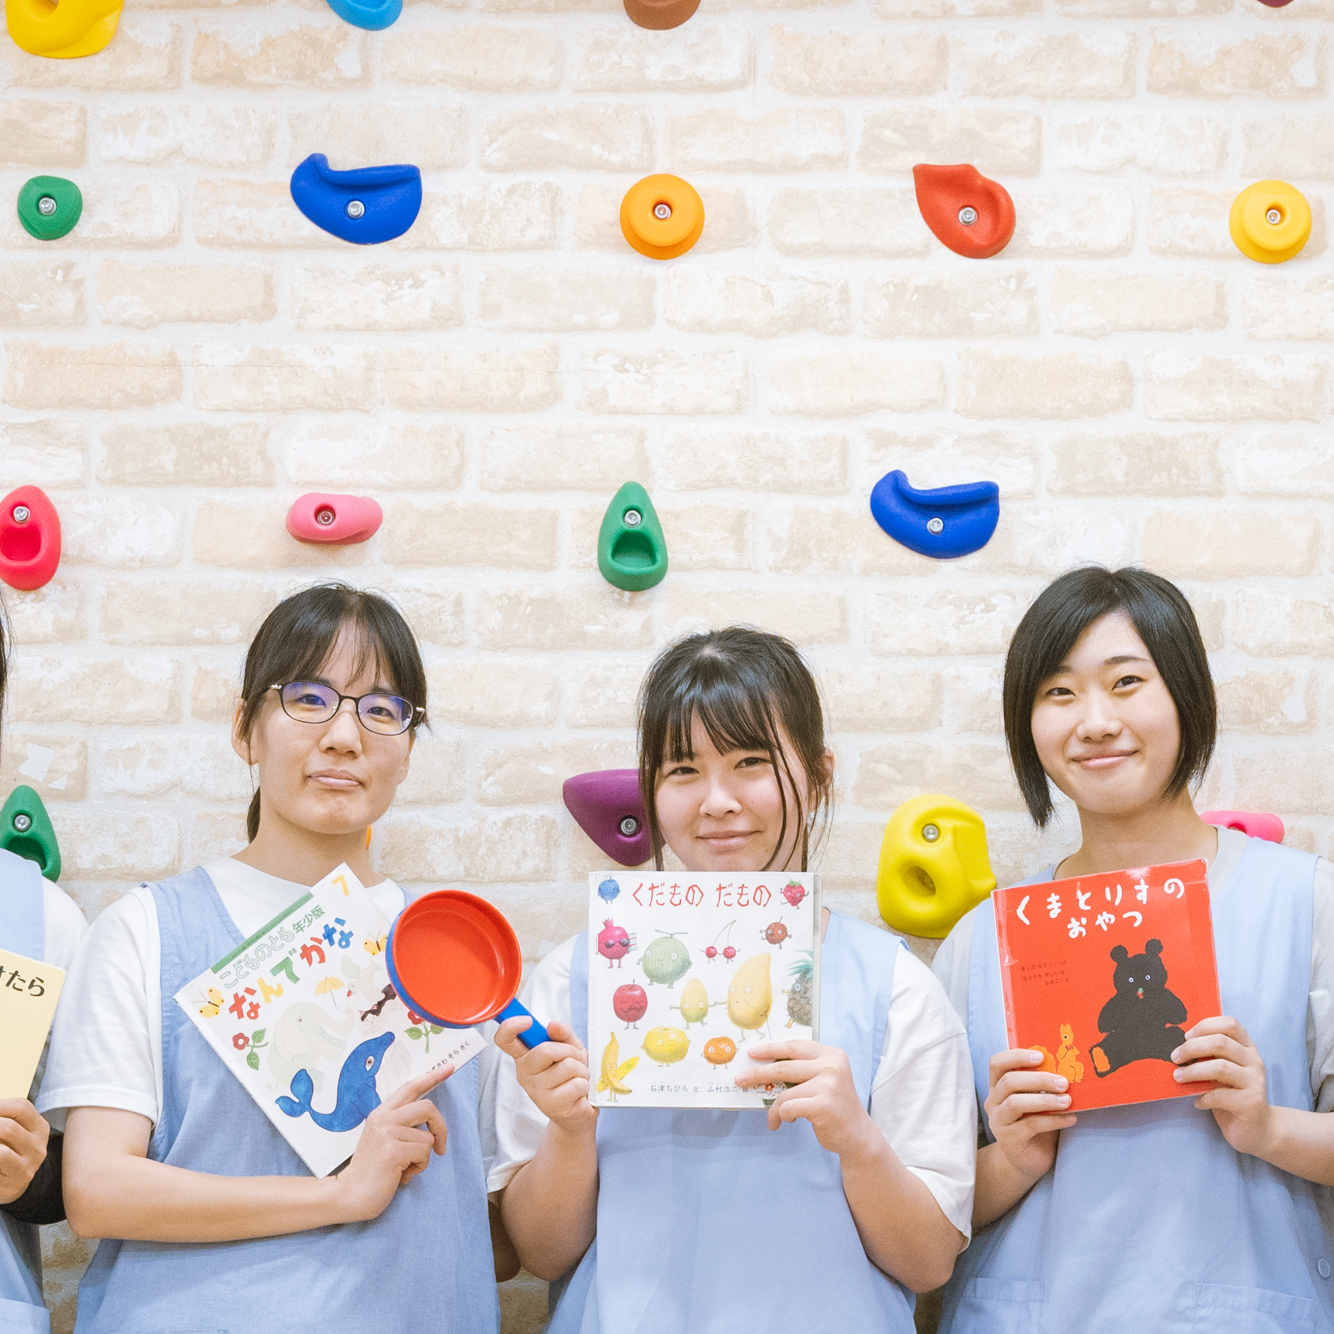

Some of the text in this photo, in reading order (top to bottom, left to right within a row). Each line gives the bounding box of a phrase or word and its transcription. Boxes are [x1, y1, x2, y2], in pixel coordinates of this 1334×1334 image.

[332, 875, 349, 896] 7
[631, 882, 773, 907] くだもの だもの
[1016, 878, 1184, 925] くまとりすの
[1067, 911, 1143, 939] おやつ
[228, 917, 354, 1021] なんでかな
[650, 1084, 688, 1093] 石津ちひろ
[707, 1085, 738, 1093] 山村浩二
